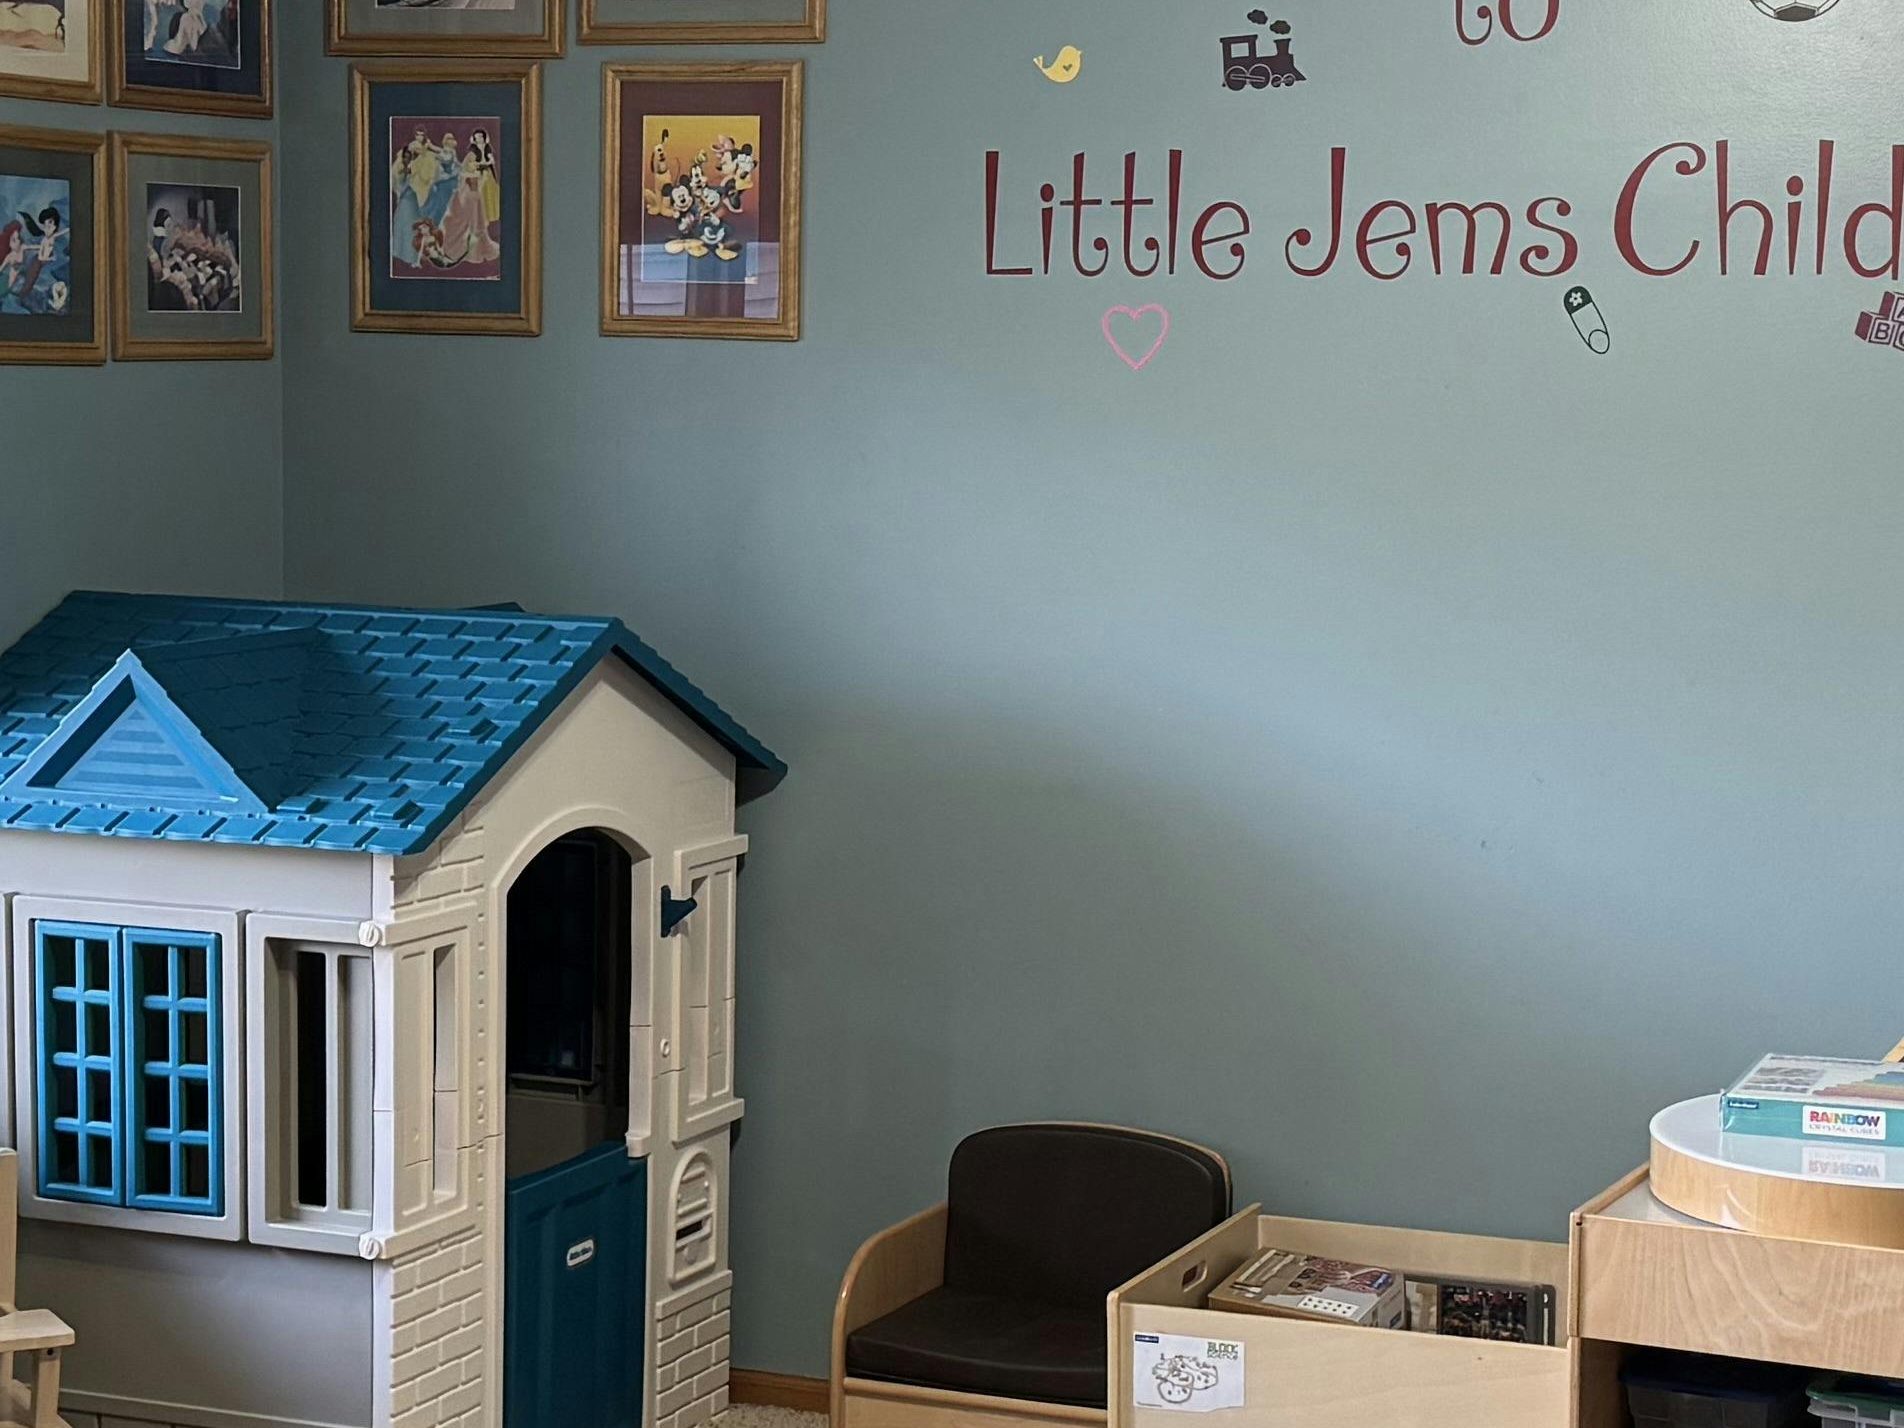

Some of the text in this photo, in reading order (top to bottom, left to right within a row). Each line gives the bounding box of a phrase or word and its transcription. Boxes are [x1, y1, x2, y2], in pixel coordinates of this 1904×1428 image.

[983, 148, 1251, 280] Little
[1282, 146, 1580, 278] Jems
[1809, 1109, 1881, 1128] RAINBOW
